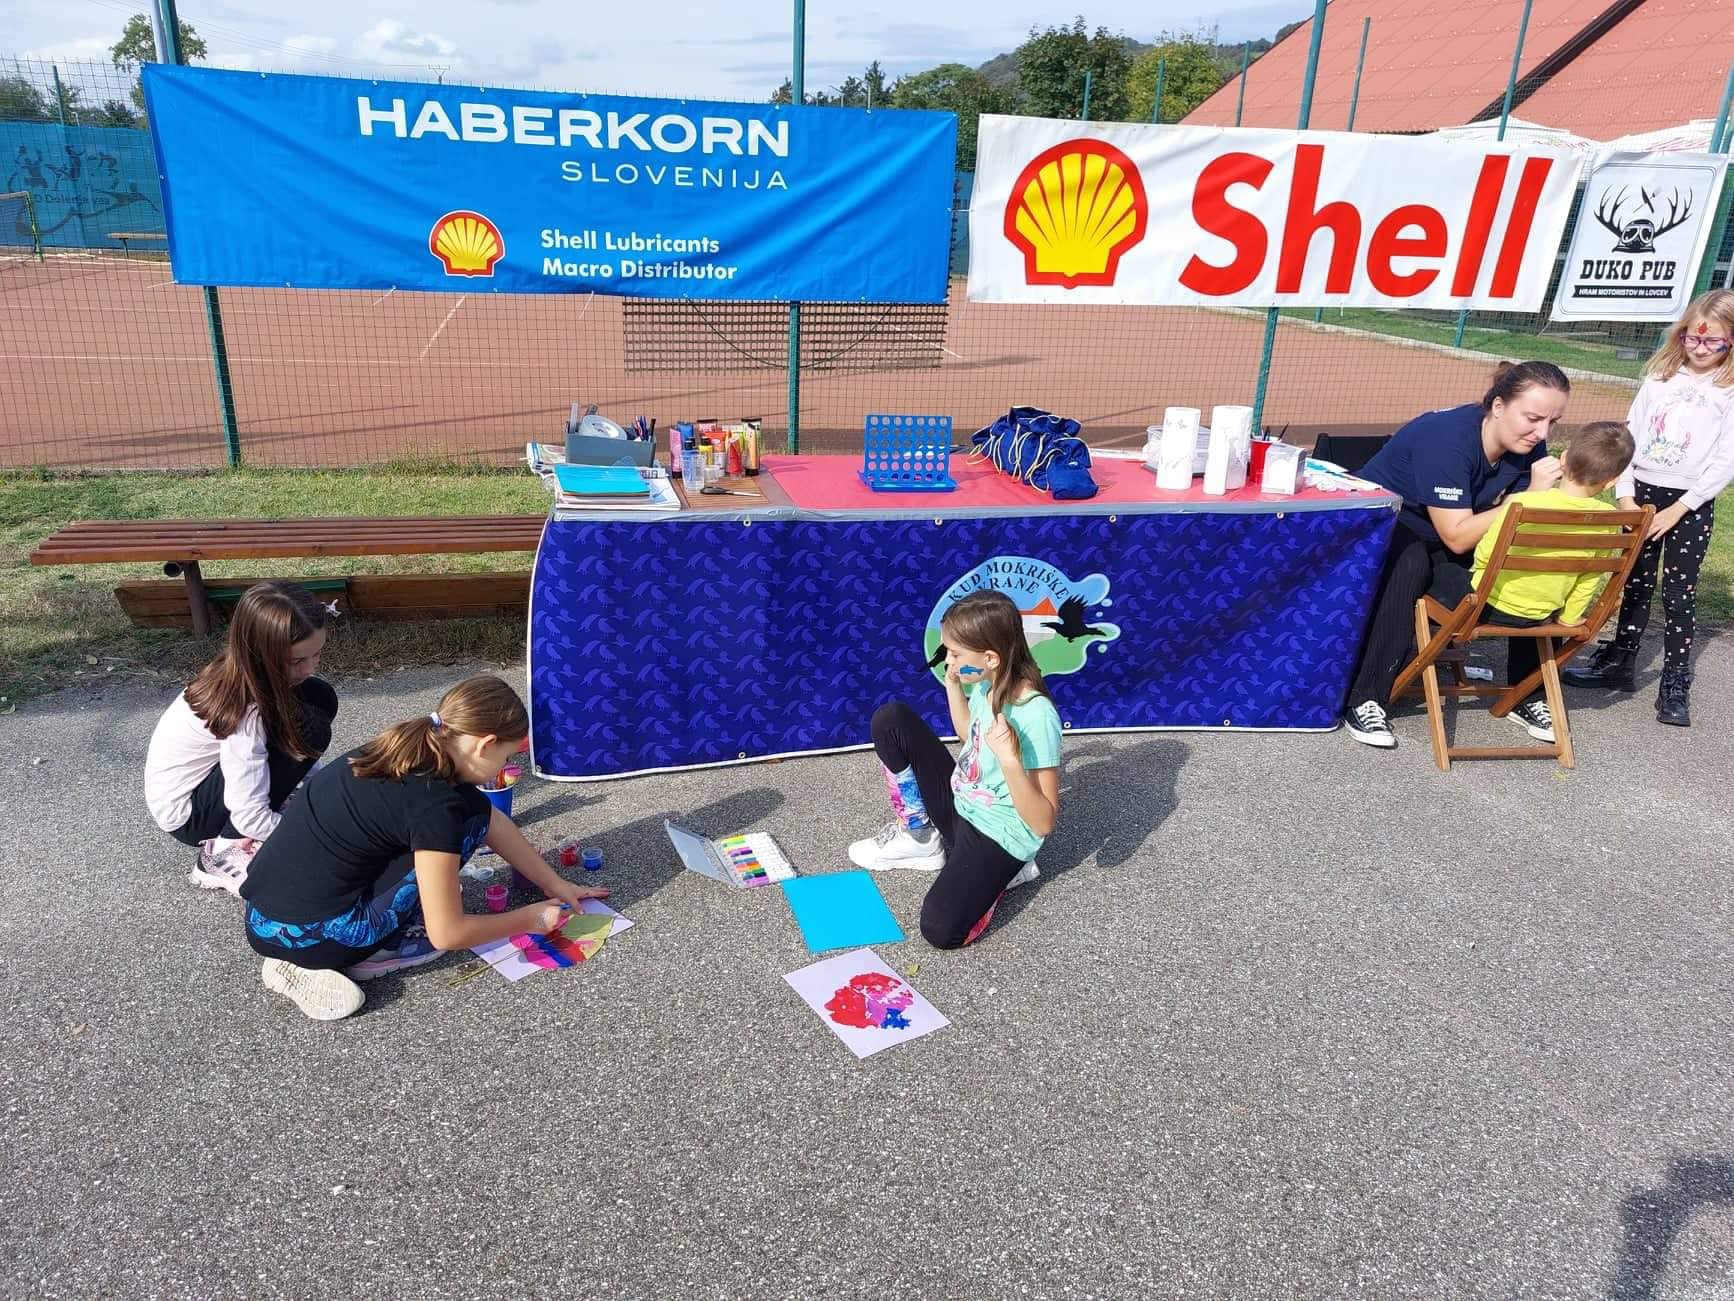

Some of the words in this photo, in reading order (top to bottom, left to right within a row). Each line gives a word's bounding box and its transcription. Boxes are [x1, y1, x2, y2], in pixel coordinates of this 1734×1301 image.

[358, 96, 789, 157] HABERKORN
[561, 161, 789, 190] SLOVENIJA
[1178, 143, 1553, 298] Shell
[541, 229, 597, 250] Shell
[605, 231, 720, 253] Lubricants
[543, 257, 613, 278] Macro
[621, 259, 738, 280] Distributor
[1579, 259, 1634, 281] DUKO
[1640, 261, 1677, 281] PUB
[948, 573, 982, 602] KUD
[986, 561, 1070, 600] MOKRIŠKE
